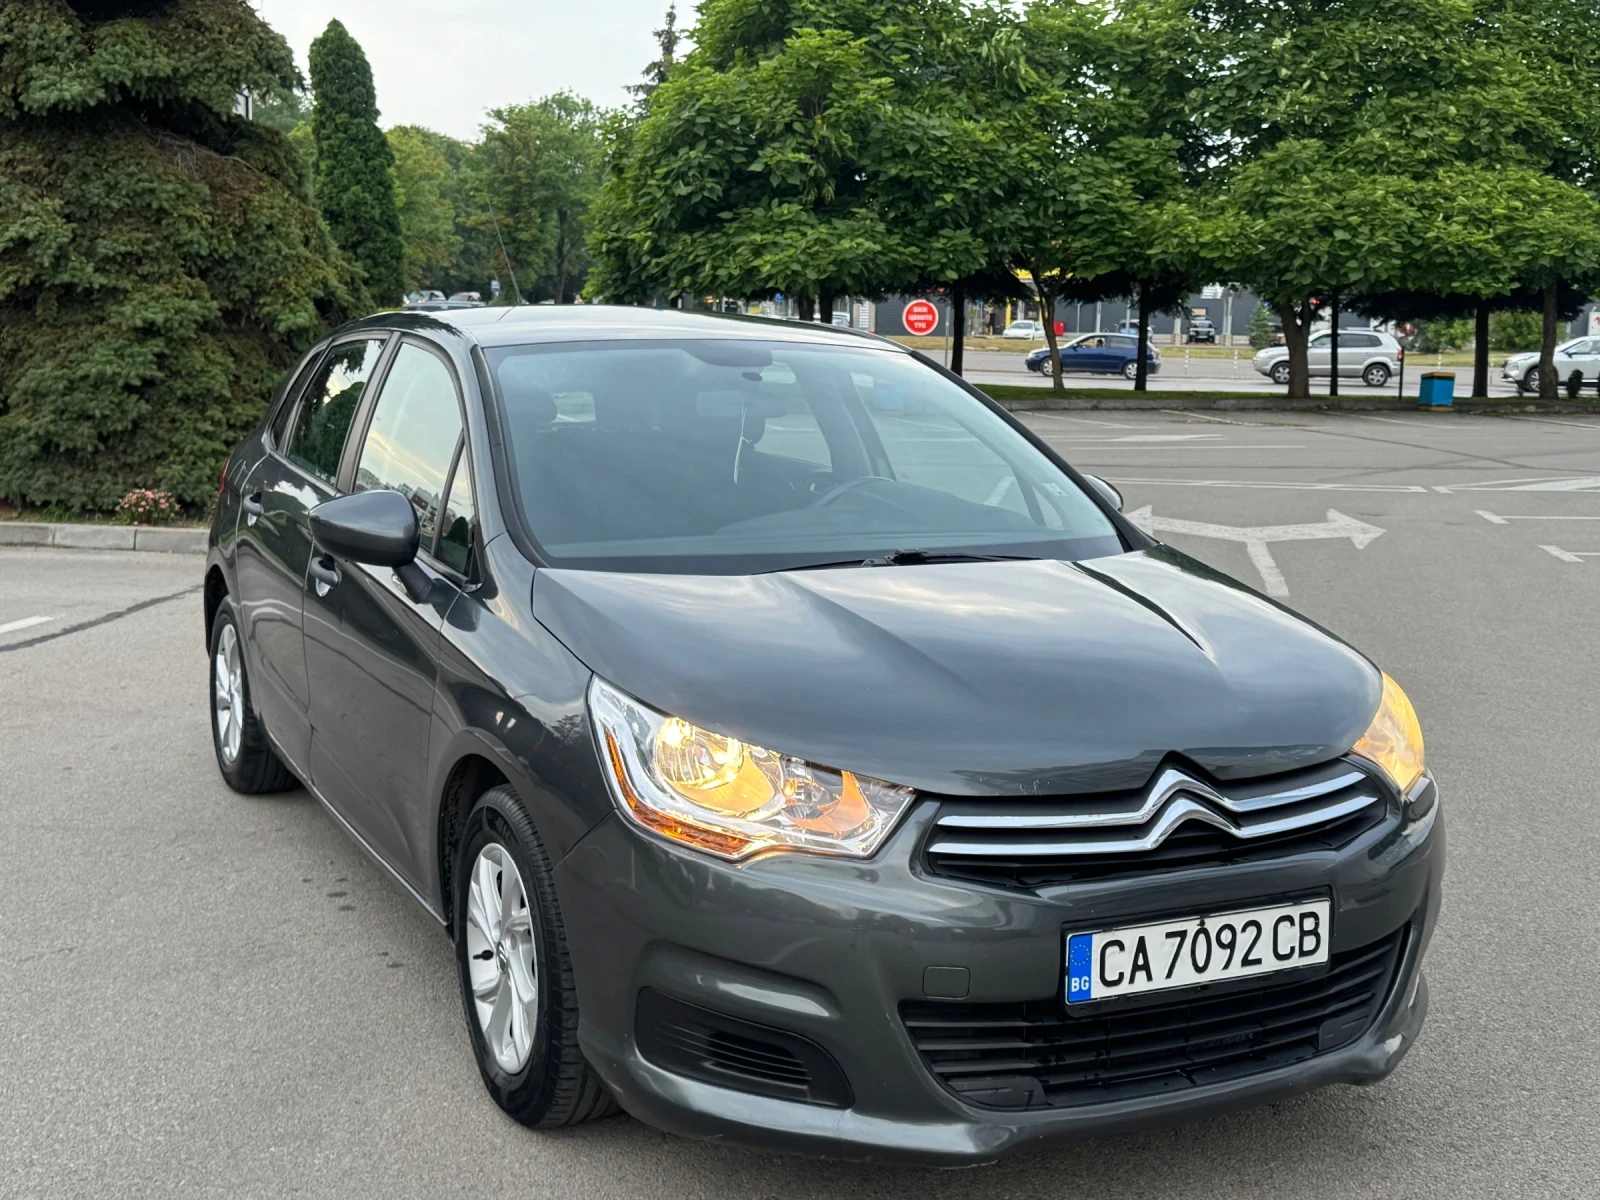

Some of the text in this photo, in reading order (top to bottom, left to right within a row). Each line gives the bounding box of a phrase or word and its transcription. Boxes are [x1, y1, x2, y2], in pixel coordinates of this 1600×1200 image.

[1099, 911, 1321, 988] CA 7092 CB
[1071, 976, 1090, 992] BG
